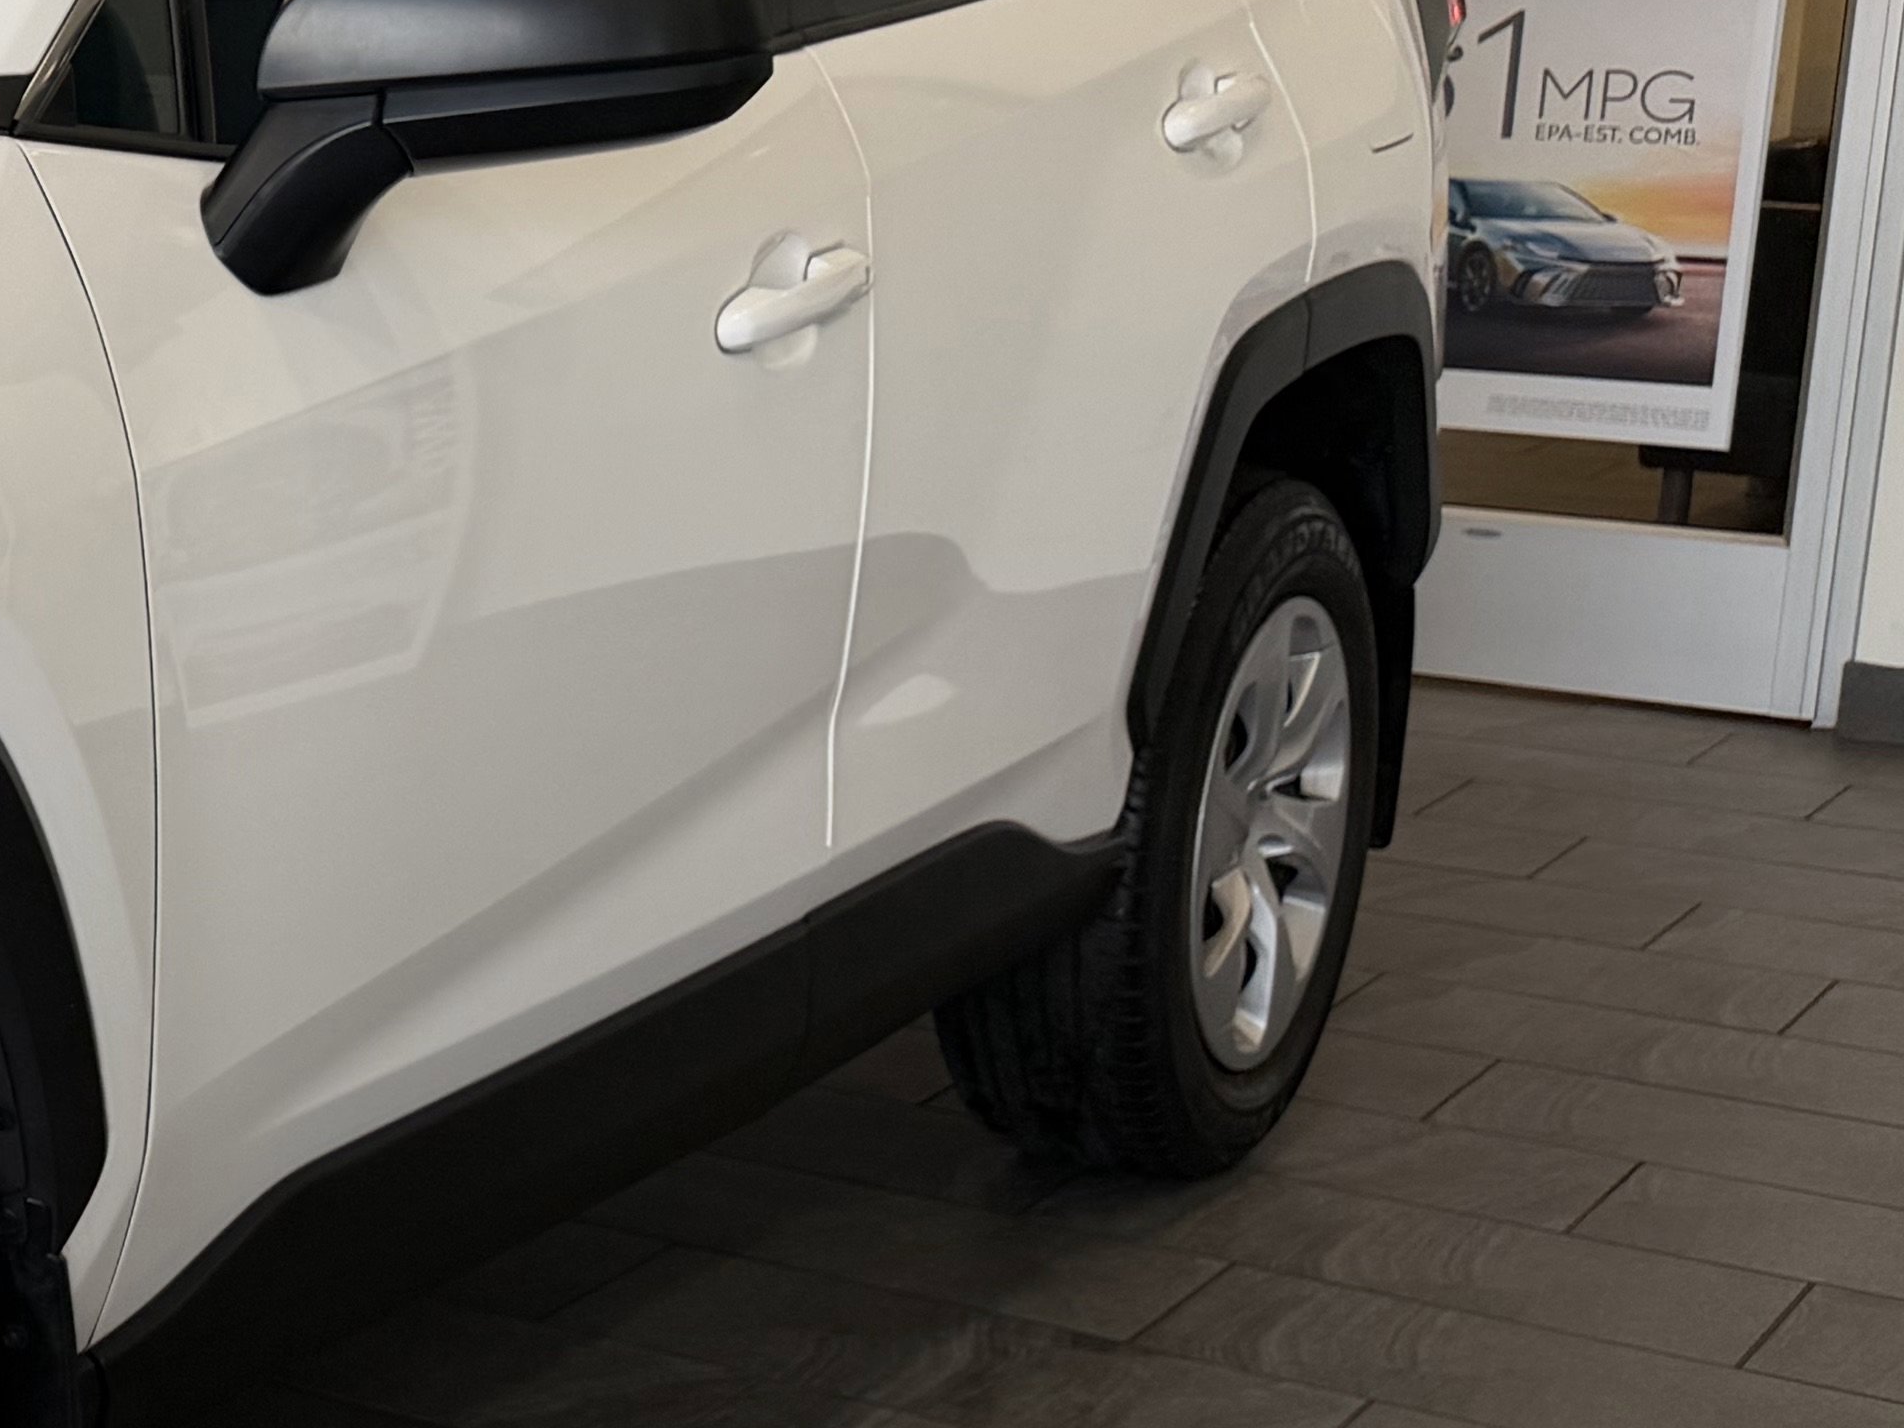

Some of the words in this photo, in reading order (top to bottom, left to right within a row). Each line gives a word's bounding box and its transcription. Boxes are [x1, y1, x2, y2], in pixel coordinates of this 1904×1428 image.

[1537, 68, 1696, 125] MPG
[1534, 124, 1622, 145] EPA-EST.
[1629, 125, 1700, 147] COMB.
